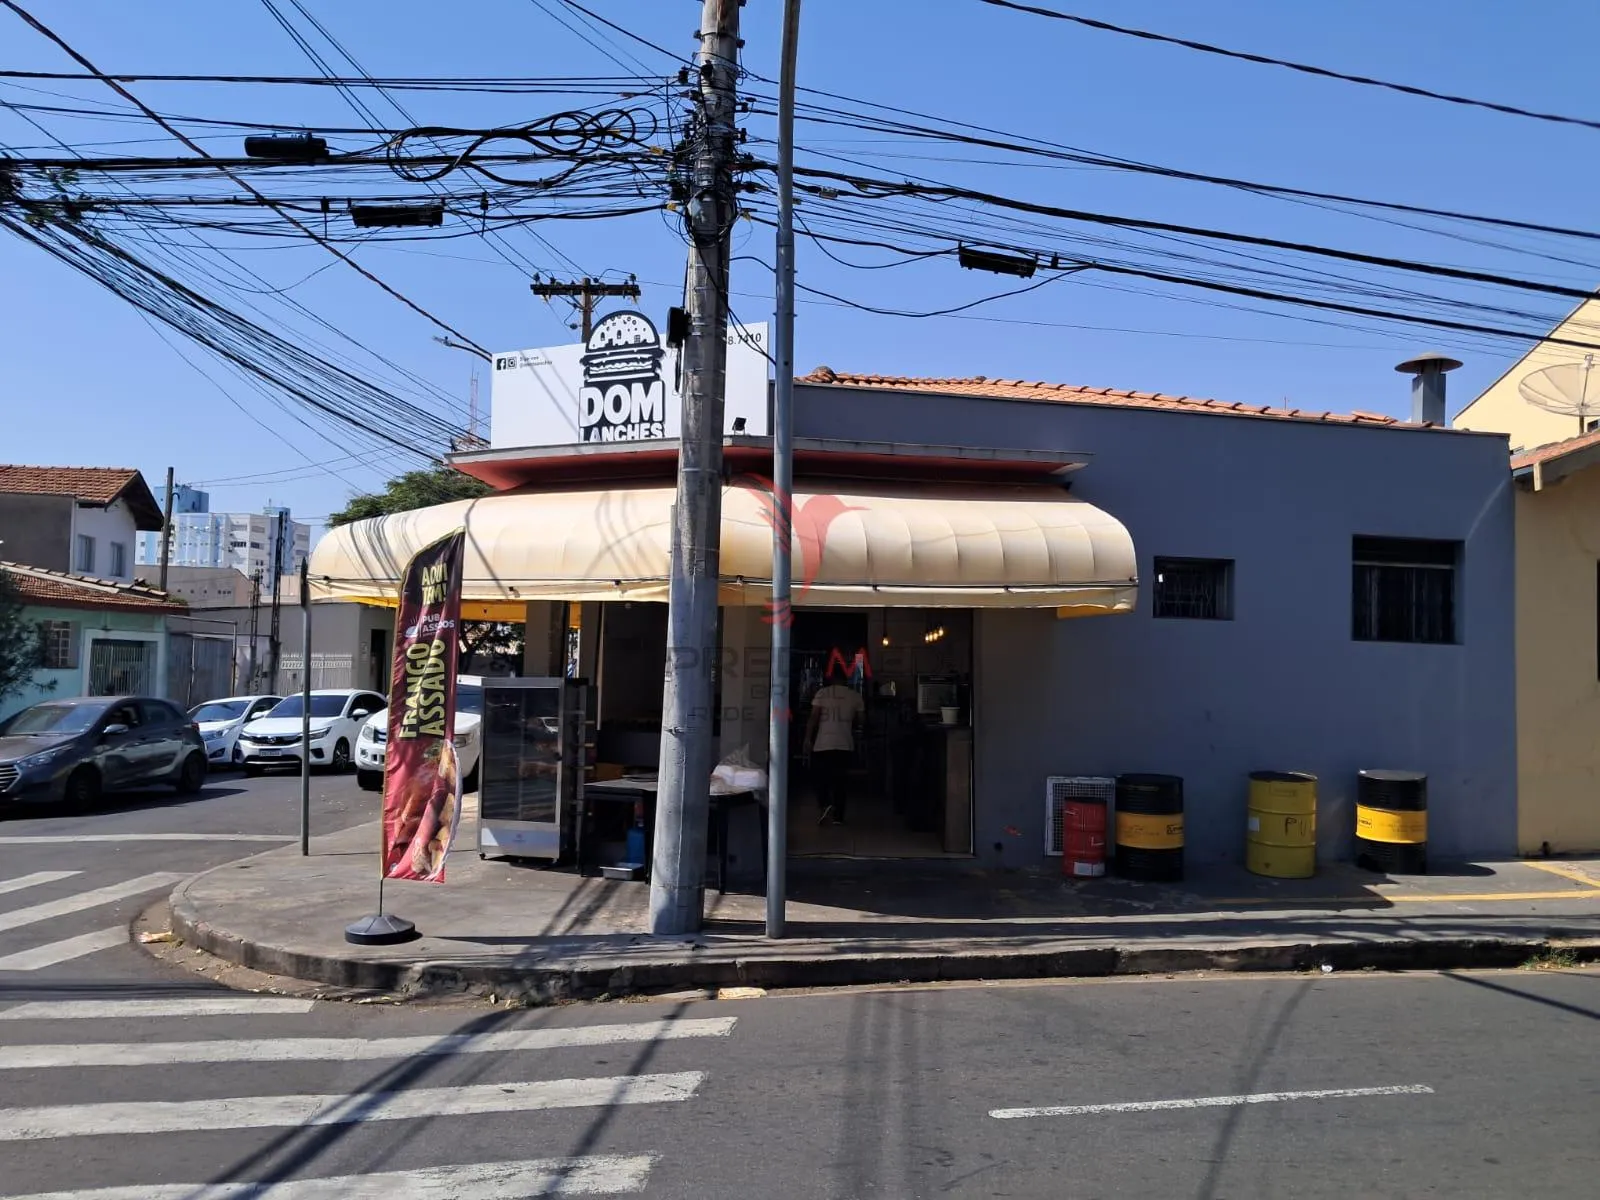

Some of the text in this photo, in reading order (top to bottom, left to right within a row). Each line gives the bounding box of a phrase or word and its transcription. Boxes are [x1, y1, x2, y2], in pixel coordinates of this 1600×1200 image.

[579, 381, 663, 427] DOM
[579, 422, 664, 443] LANCHES
[422, 613, 441, 623] PUB
[398, 642, 431, 738] FRANGO
[418, 639, 447, 736] ASSADO
